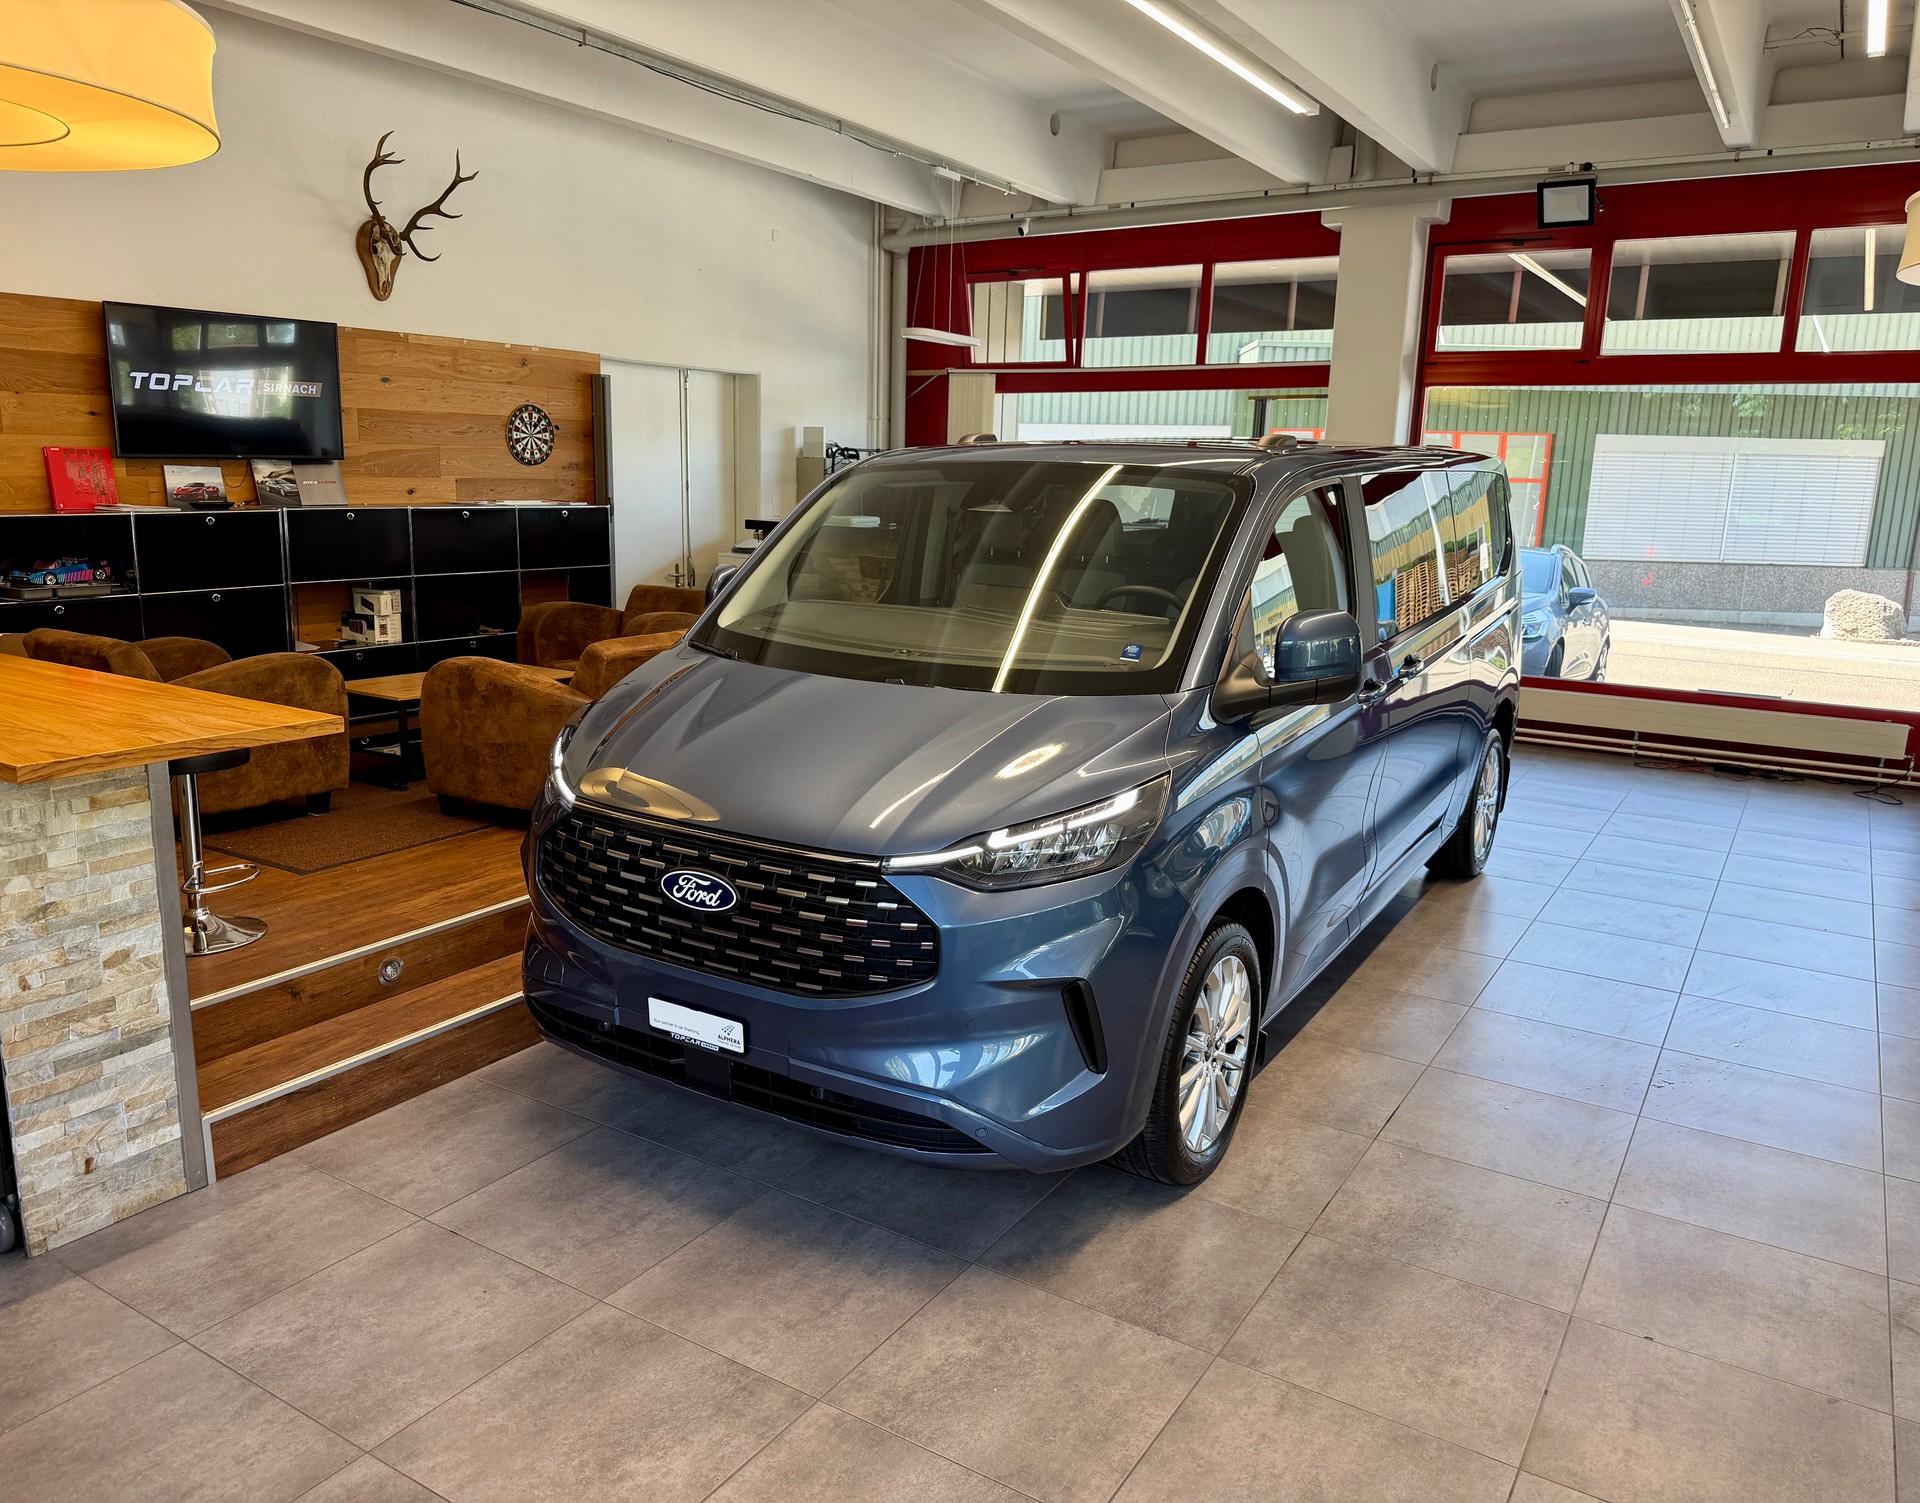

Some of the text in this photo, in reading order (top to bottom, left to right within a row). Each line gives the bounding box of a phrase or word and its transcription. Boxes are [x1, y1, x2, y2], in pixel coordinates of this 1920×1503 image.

[129, 371, 317, 395] TOPCAR SIRNACH
[672, 875, 723, 907] Ford
[670, 1032, 700, 1046] TOPCAR
